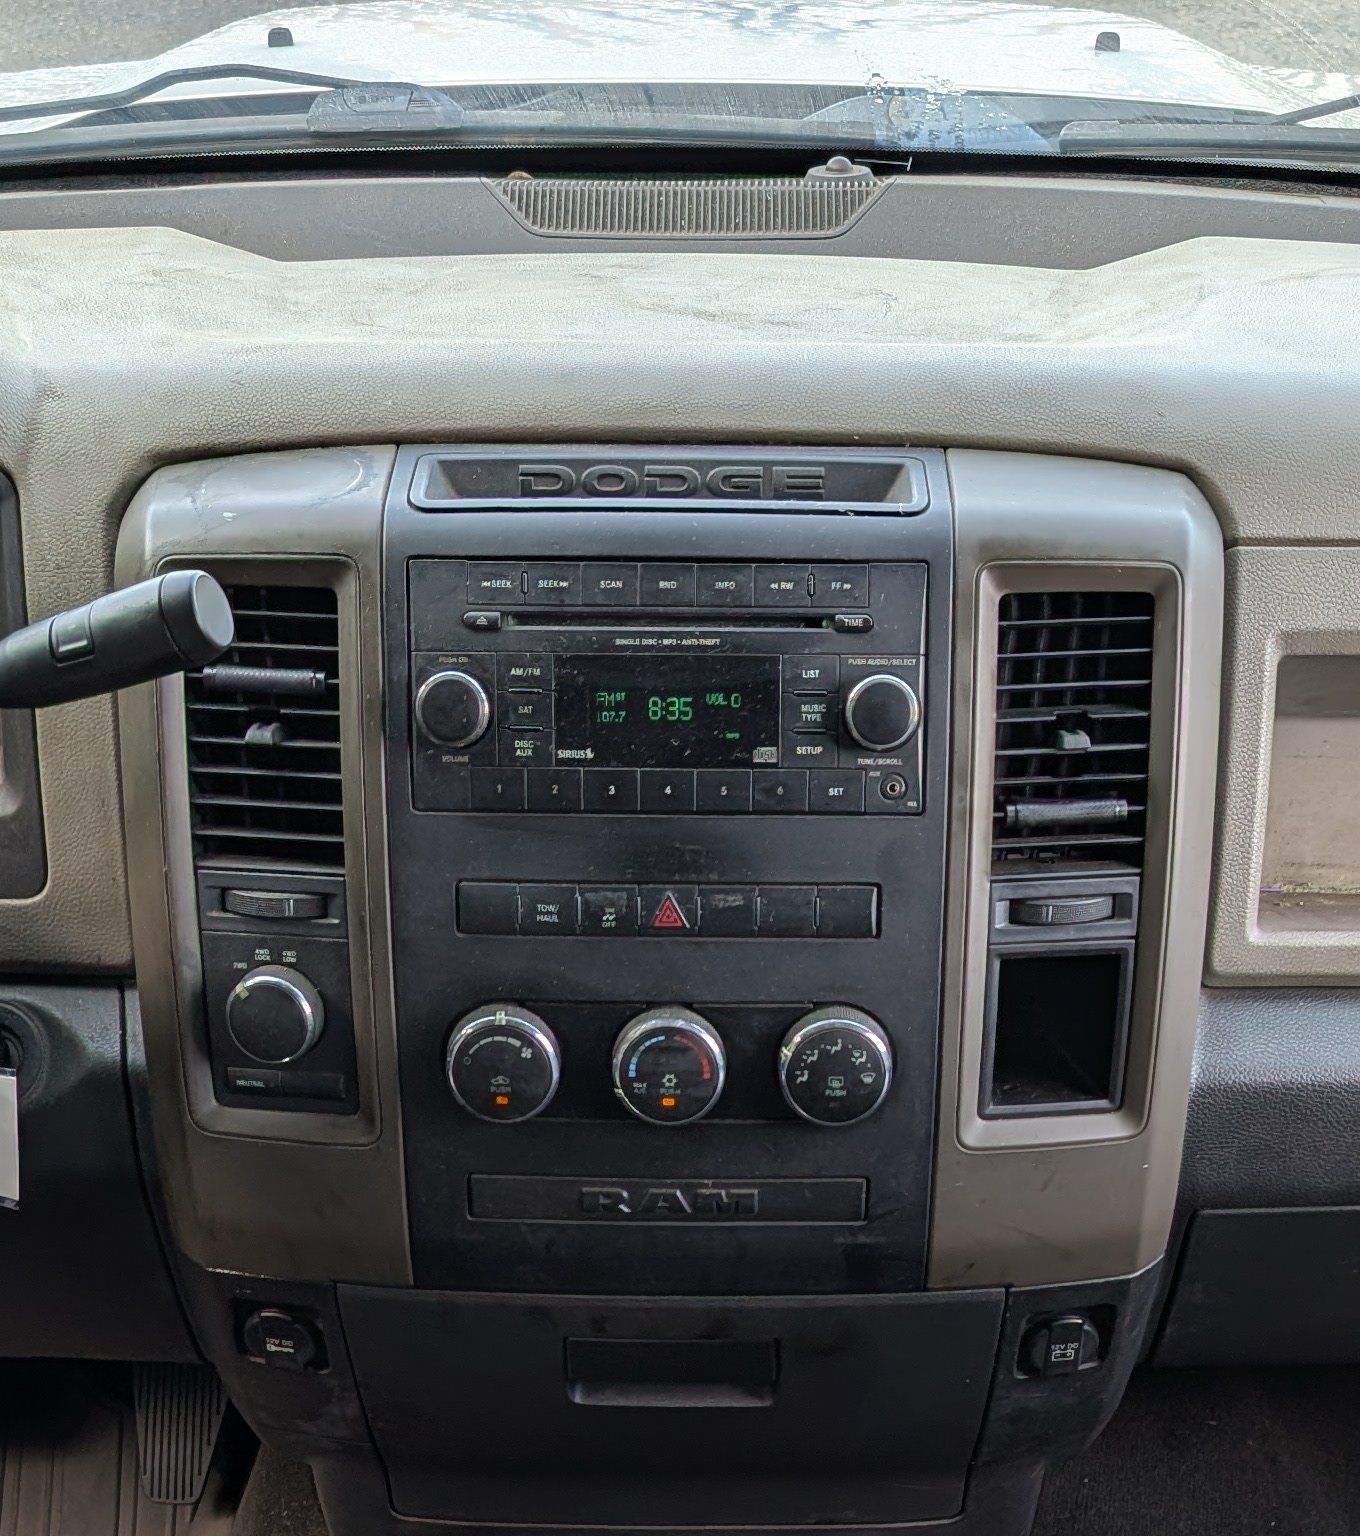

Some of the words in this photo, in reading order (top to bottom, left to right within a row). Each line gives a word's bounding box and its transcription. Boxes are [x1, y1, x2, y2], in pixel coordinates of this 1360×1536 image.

[518, 465, 825, 499] DODGE
[491, 580, 512, 588] SEEK
[538, 580, 558, 588] SEEK
[600, 580, 623, 589] SCAN
[659, 581, 677, 589] RND
[715, 581, 736, 589] INFO
[844, 618, 864, 627] TIME
[510, 667, 540, 676] AM/FM
[802, 669, 819, 678] LIST
[518, 705, 533, 714] SAT
[649, 696, 693, 721] 8:35
[801, 704, 827, 712] MUSIC
[596, 711, 626, 723] 107.7
[802, 713, 822, 722] TYPE
[514, 740, 534, 748] DISC
[515, 749, 533, 757] AUX
[557, 749, 585, 759] SIRIUS
[796, 746, 823, 755] SETUP
[551, 784, 559, 795] 2
[608, 785, 616, 795] 3
[664, 785, 672, 795] 4
[720, 785, 728, 796] 5
[776, 786, 784, 795] 6
[828, 787, 844, 796] SET
[536, 903, 560, 912] TOW/
[536, 914, 559, 923] HAUL
[825, 1089, 847, 1097] PUSH
[581, 1186, 760, 1215] RAM
